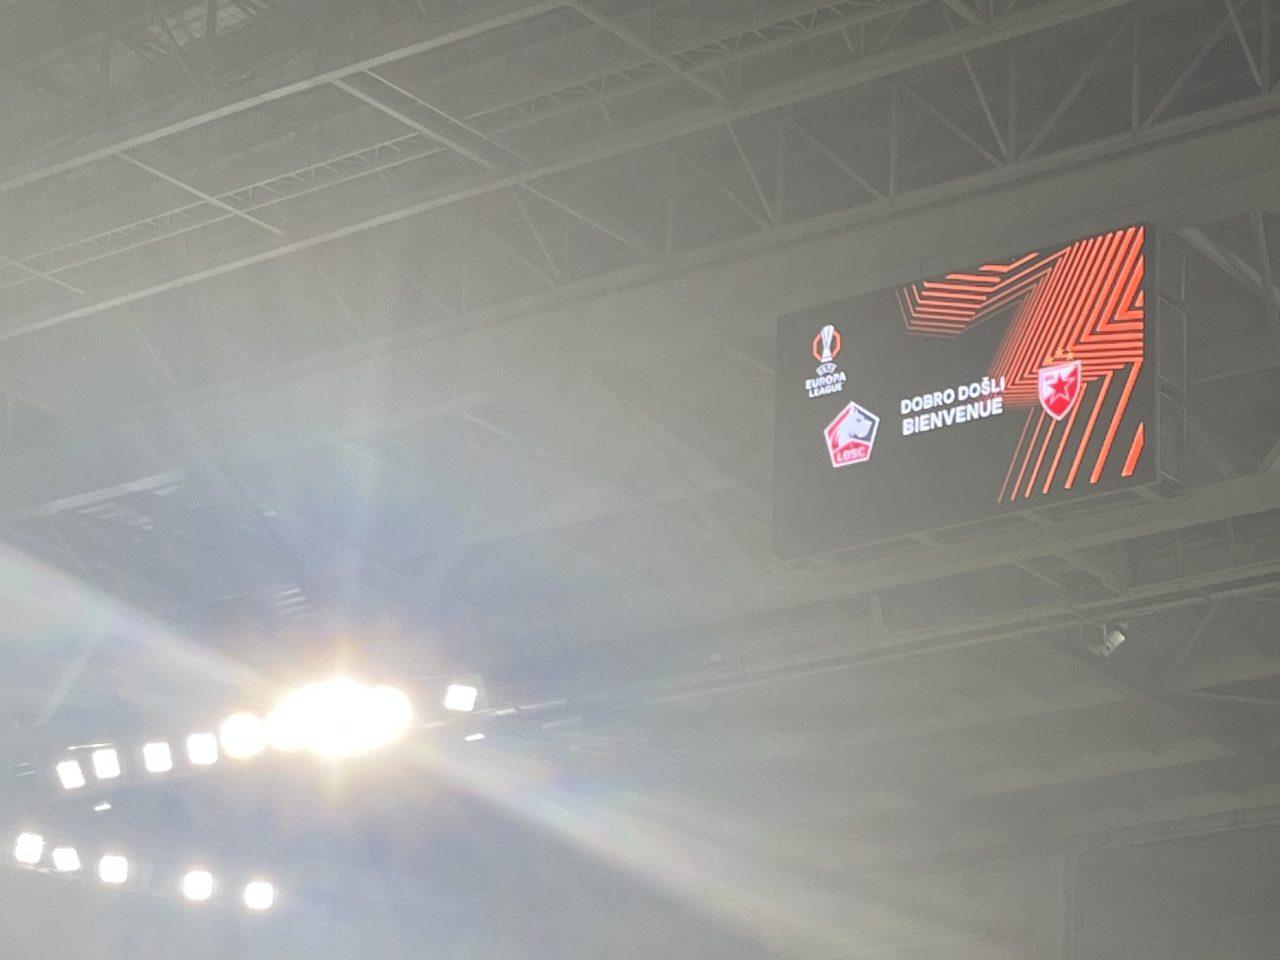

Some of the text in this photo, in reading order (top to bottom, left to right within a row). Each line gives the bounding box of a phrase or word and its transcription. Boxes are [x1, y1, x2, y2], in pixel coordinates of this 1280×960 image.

[805, 371, 847, 390] EUROPA
[808, 382, 843, 398] LEAGUE
[900, 376, 1006, 415] DOBRO DOŠLI
[902, 397, 1003, 436] BIENVENUE
